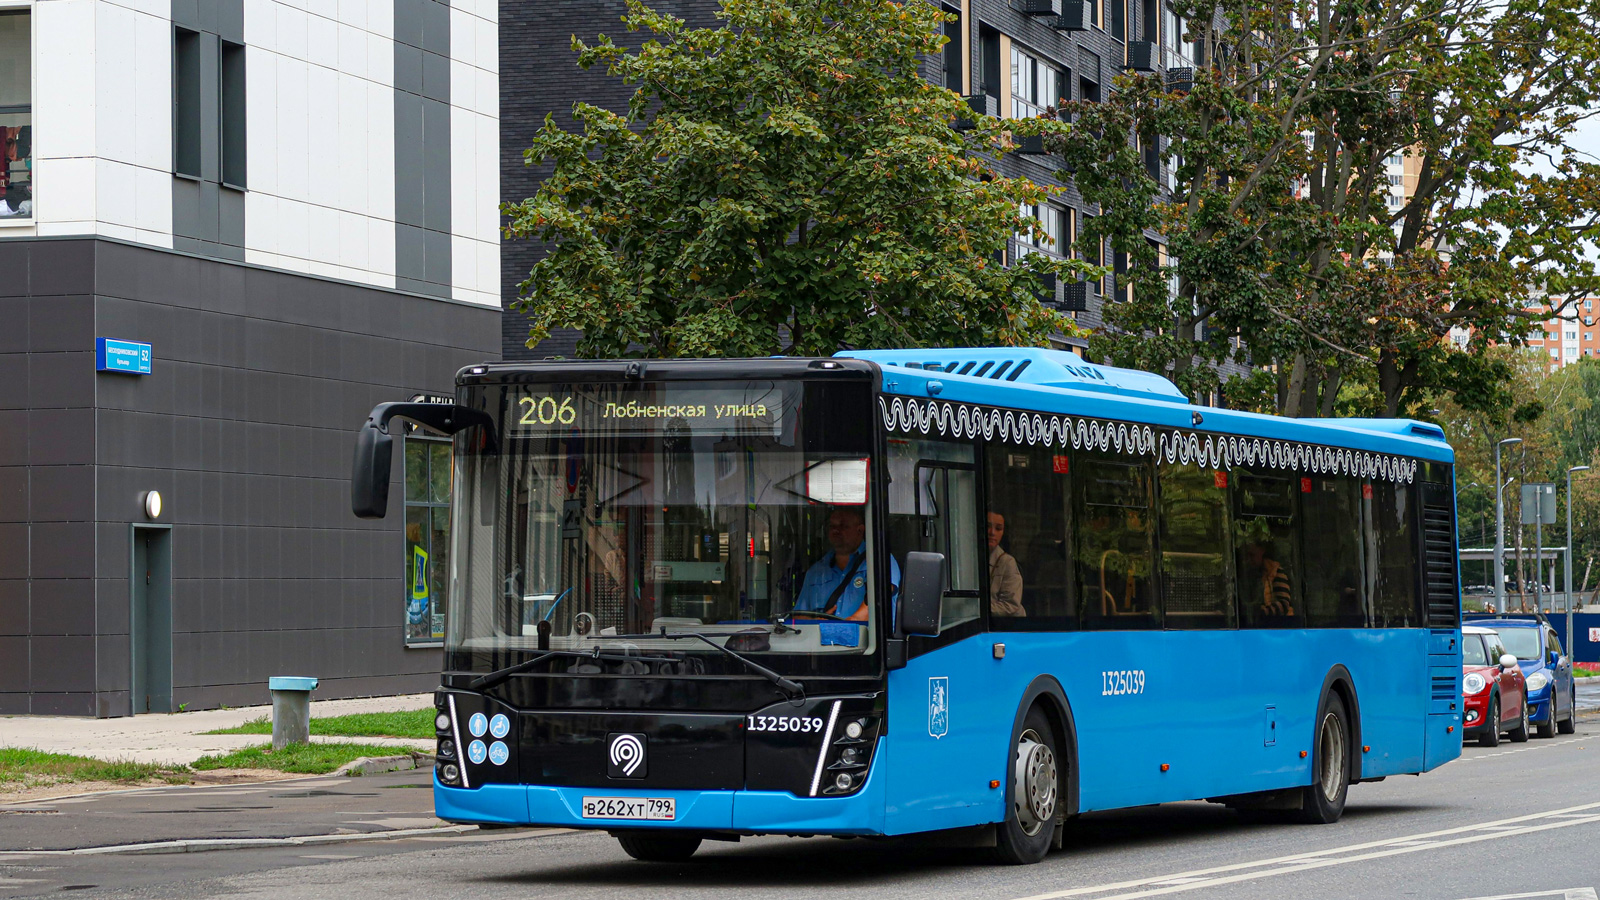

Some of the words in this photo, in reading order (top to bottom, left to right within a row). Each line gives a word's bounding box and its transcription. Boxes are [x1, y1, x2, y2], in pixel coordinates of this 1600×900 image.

[141, 350, 149, 361] 52
[518, 396, 576, 425] 206
[602, 400, 706, 418] Лобненская
[714, 403, 767, 420] улица
[1102, 669, 1145, 696] 1325039
[747, 716, 823, 733] 1325039
[648, 799, 671, 813] 799
